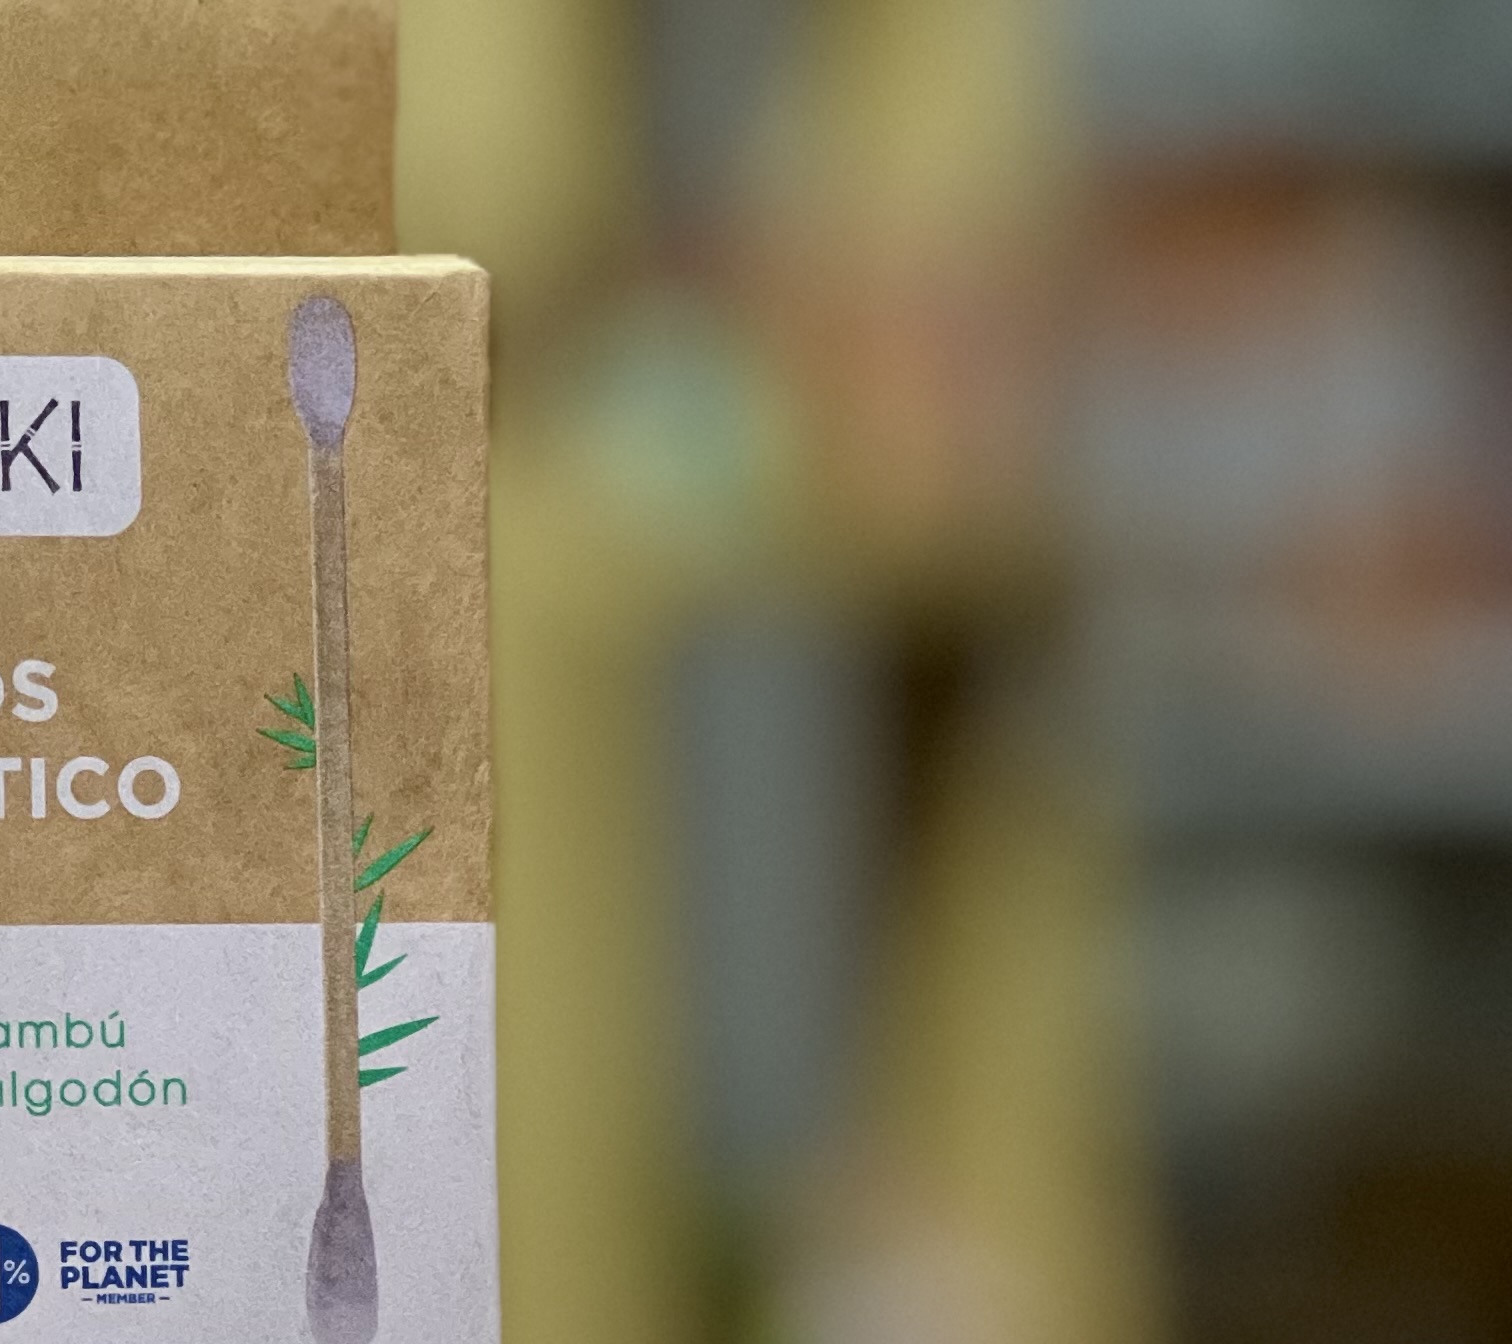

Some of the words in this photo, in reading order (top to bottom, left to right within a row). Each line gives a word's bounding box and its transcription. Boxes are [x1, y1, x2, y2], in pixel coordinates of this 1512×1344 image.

[60, 1240, 123, 1262] FOR
[129, 1240, 189, 1261] THE
[60, 1265, 189, 1289] PLANET
[96, 1293, 156, 1304] MEMBER
